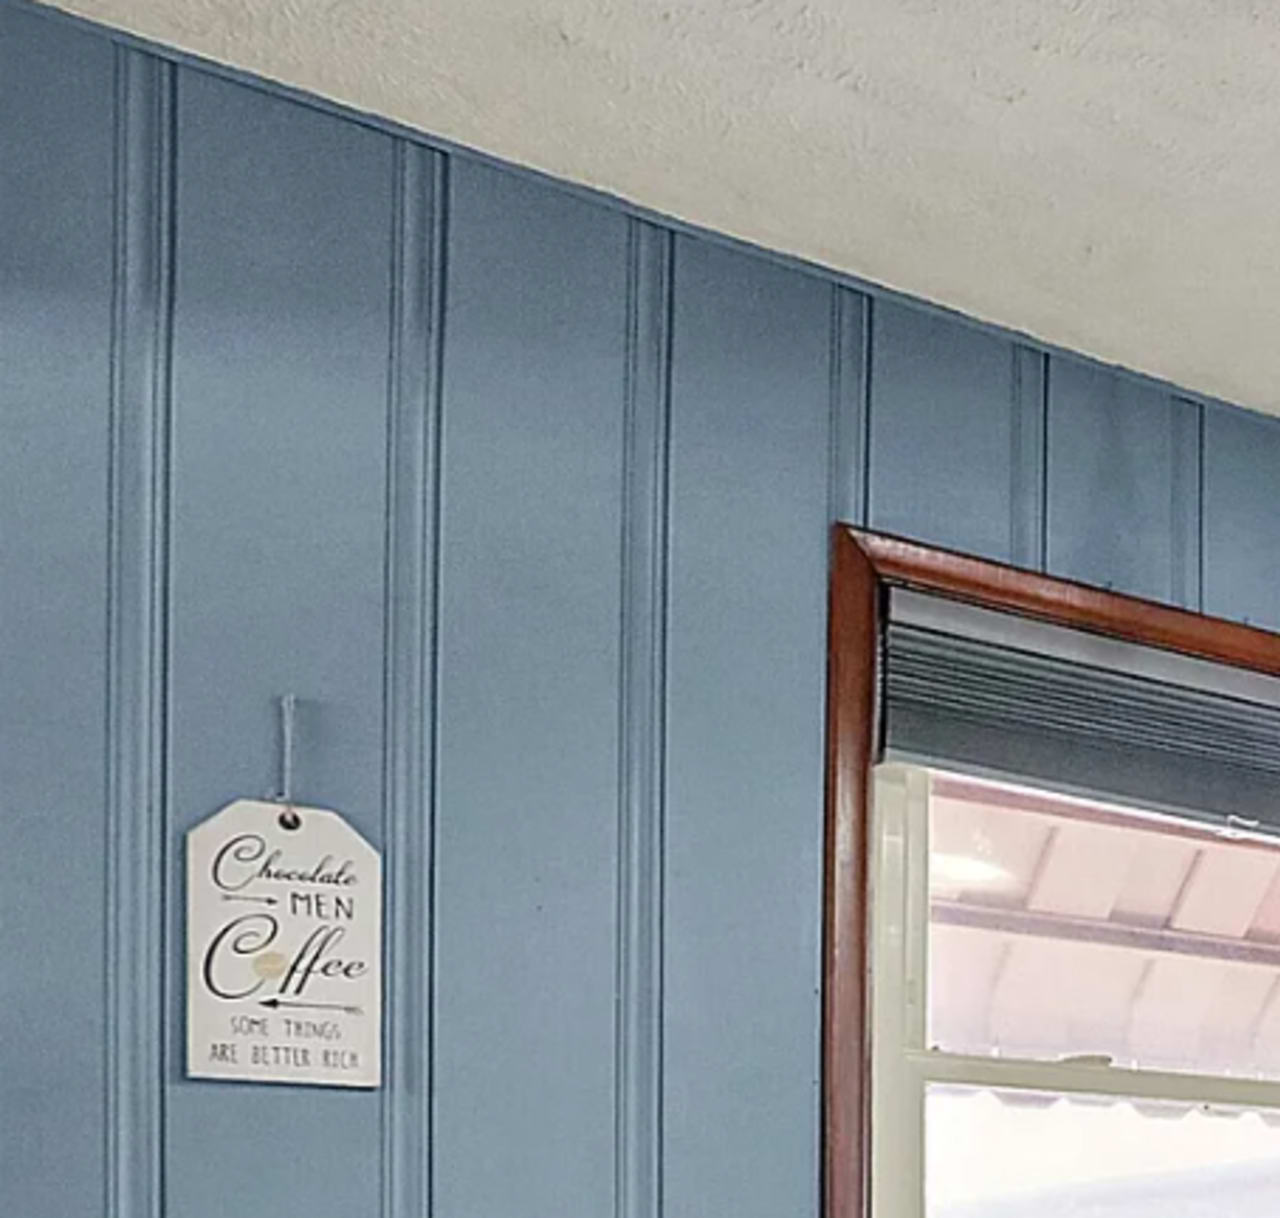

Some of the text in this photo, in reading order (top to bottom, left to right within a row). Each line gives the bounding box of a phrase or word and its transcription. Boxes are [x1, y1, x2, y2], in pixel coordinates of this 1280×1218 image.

[211, 834, 359, 892] Chocolate
[289, 891, 355, 921] MEN
[230, 1015, 342, 1041] SOME THINGS
[208, 1042, 360, 1070] ARE BETTER RICH
